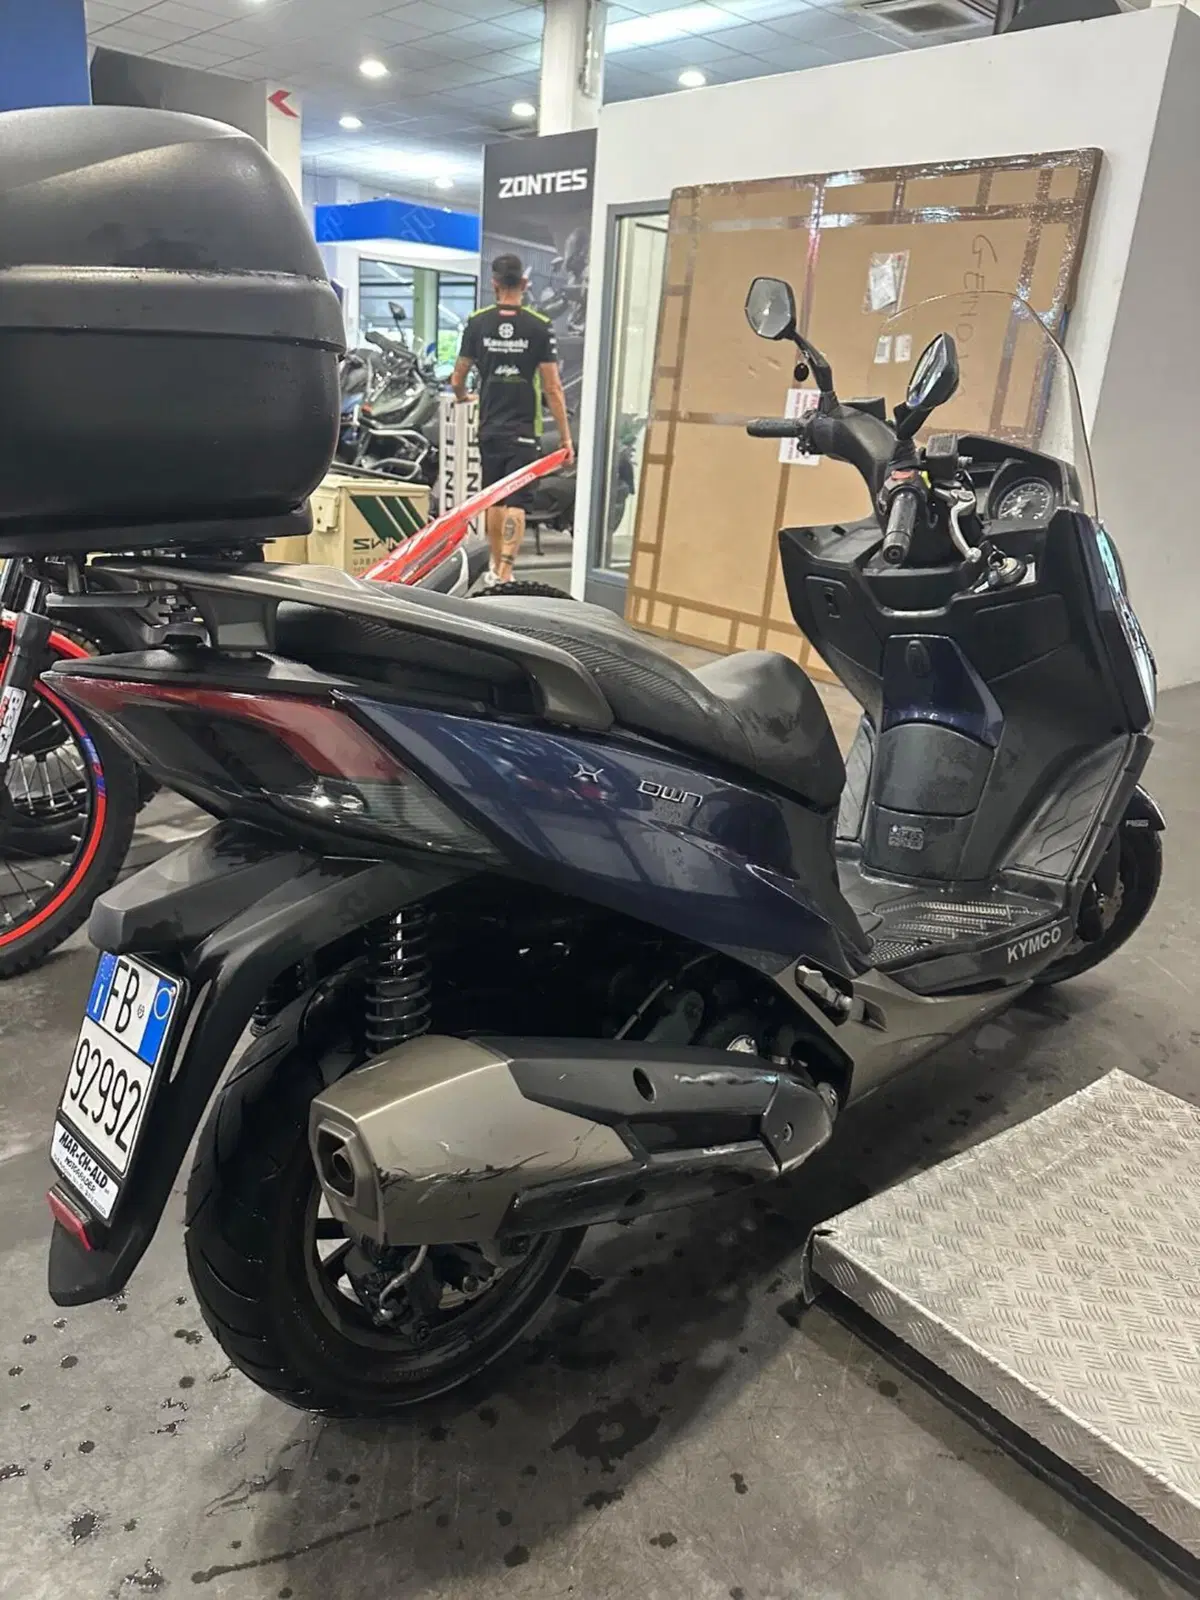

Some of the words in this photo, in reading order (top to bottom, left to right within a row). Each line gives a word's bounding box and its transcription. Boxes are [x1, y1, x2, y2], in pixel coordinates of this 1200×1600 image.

[499, 168, 588, 199] ZONTES
[1007, 926, 1062, 964] KYMCO
[102, 961, 140, 1034] FB
[70, 1038, 142, 1154] 92992
